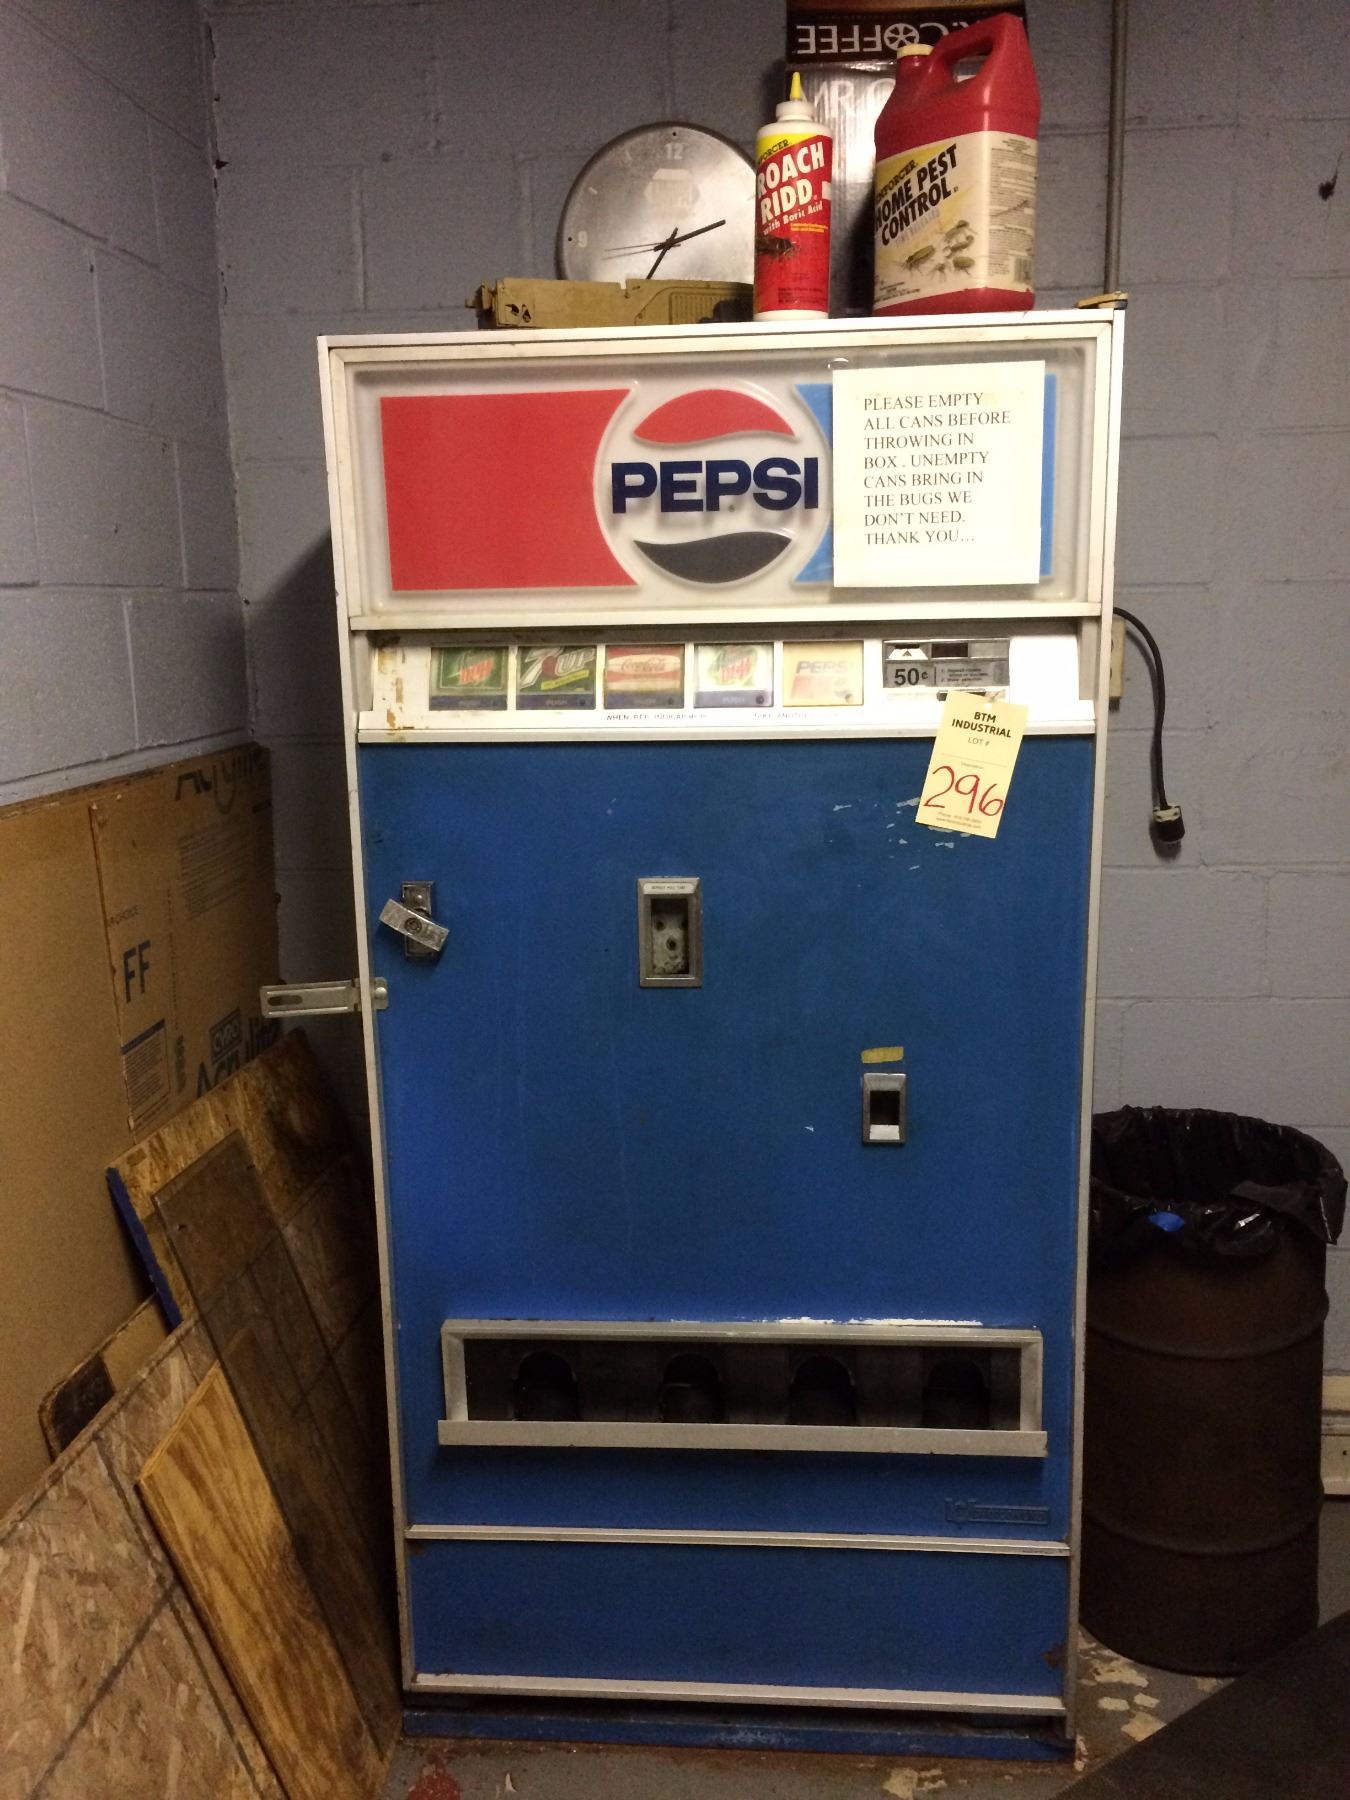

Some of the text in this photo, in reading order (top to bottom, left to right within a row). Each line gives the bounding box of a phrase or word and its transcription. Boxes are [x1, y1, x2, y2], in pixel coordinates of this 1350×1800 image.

[665, 143, 683, 160] 12
[757, 141, 825, 199] ROACH
[875, 178, 914, 232] HOME
[917, 143, 957, 192] PEST
[760, 178, 813, 225] RIDD
[763, 219, 781, 236] with
[783, 208, 806, 225] Boric
[807, 200, 823, 215] Acid
[882, 176, 952, 246] CONTROL
[577, 230, 588, 248] 9
[864, 392, 985, 411] PLEASE EMPTY
[864, 411, 1012, 431] ALL CANS BEFORE
[864, 432, 974, 450] THROWING IN
[910, 451, 990, 468] UNEMPTY
[611, 457, 819, 514] PEPSI
[864, 471, 984, 489] CANS BRING IN
[864, 490, 973, 508] THE BUGS WE
[865, 510, 966, 527] DON'T NEED.
[864, 531, 920, 545] THANK
[796, 660, 856, 674] PEPS
[973, 711, 997, 724] BTM
[951, 718, 1012, 738] INDUSTRIAL
[967, 737, 983, 745] LOT
[923, 765, 1004, 817] 296
[123, 939, 151, 1004] FF
